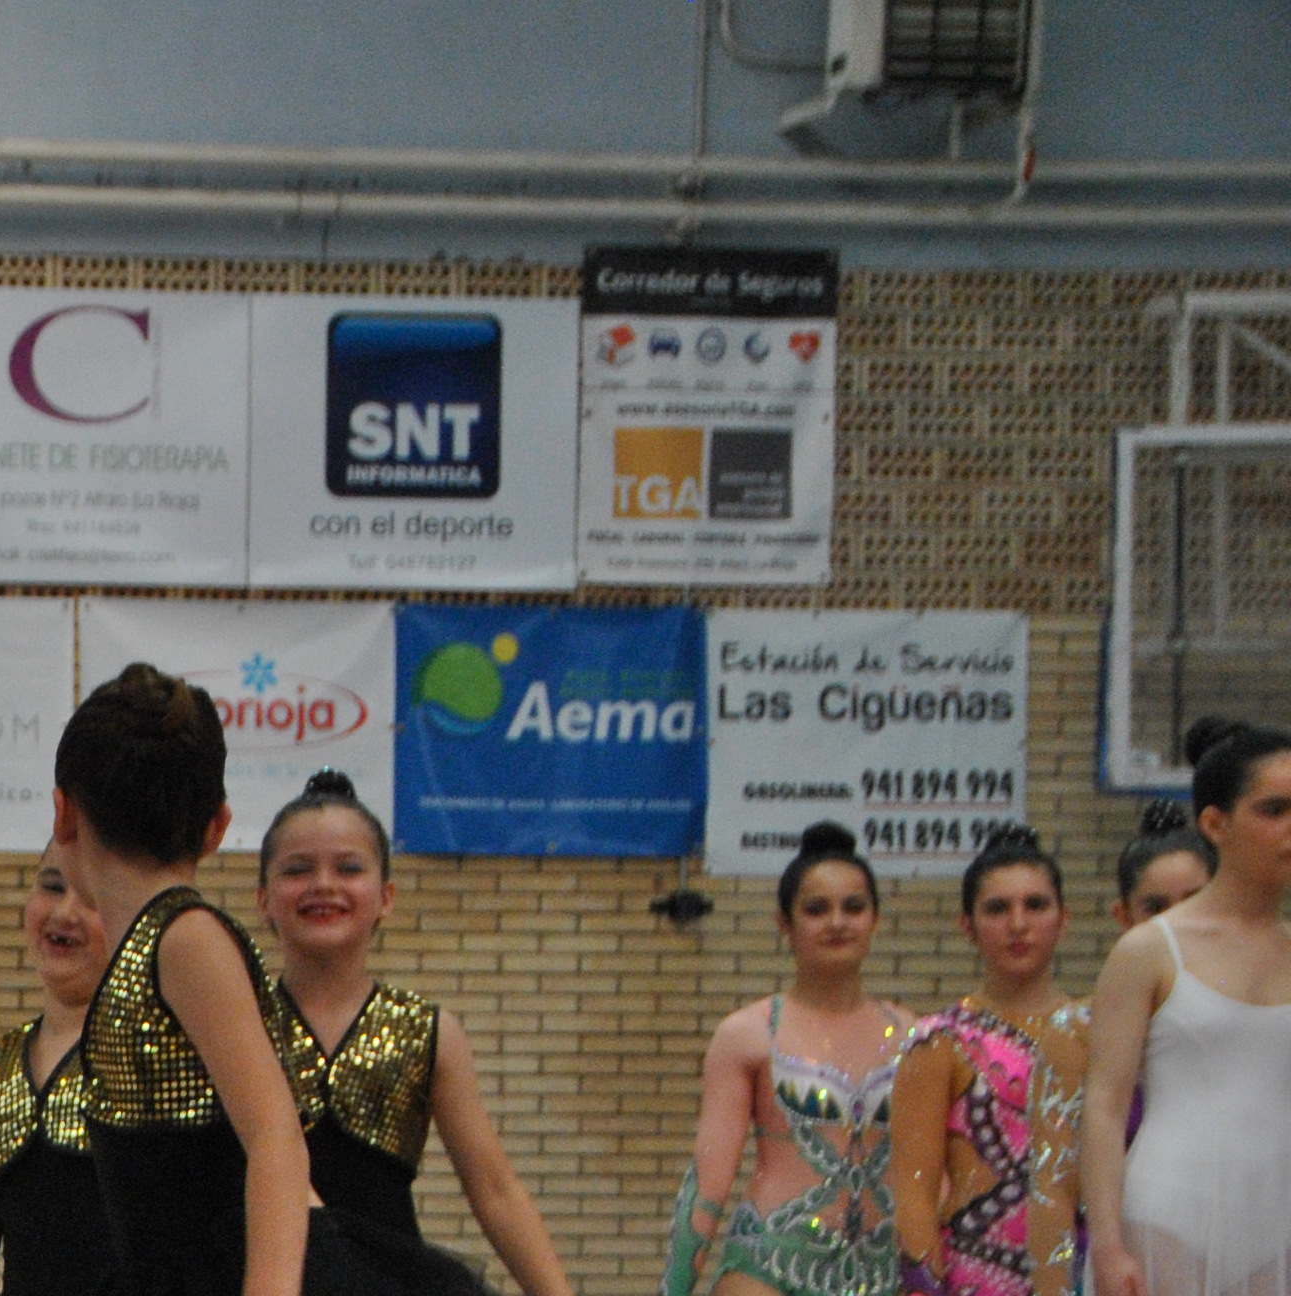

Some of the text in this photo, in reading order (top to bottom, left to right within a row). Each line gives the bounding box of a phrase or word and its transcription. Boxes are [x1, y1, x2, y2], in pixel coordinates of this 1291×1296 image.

[597, 267, 824, 300] Corredor de Seguros
[7, 303, 152, 426] C
[346, 400, 482, 462] SNT
[48, 443, 78, 470] DE
[88, 443, 230, 472] FISIOTERAPIA
[616, 474, 703, 514] TGA
[309, 509, 515, 544] con el deporte
[853, 647, 889, 675] de
[899, 642, 1015, 675] Servicio
[505, 680, 696, 743] Aema
[718, 682, 793, 722] Las
[861, 768, 904, 801] 941
[912, 769, 958, 804] 894
[966, 768, 1015, 804] 994
[862, 817, 907, 850] 941
[914, 818, 961, 851] 894
